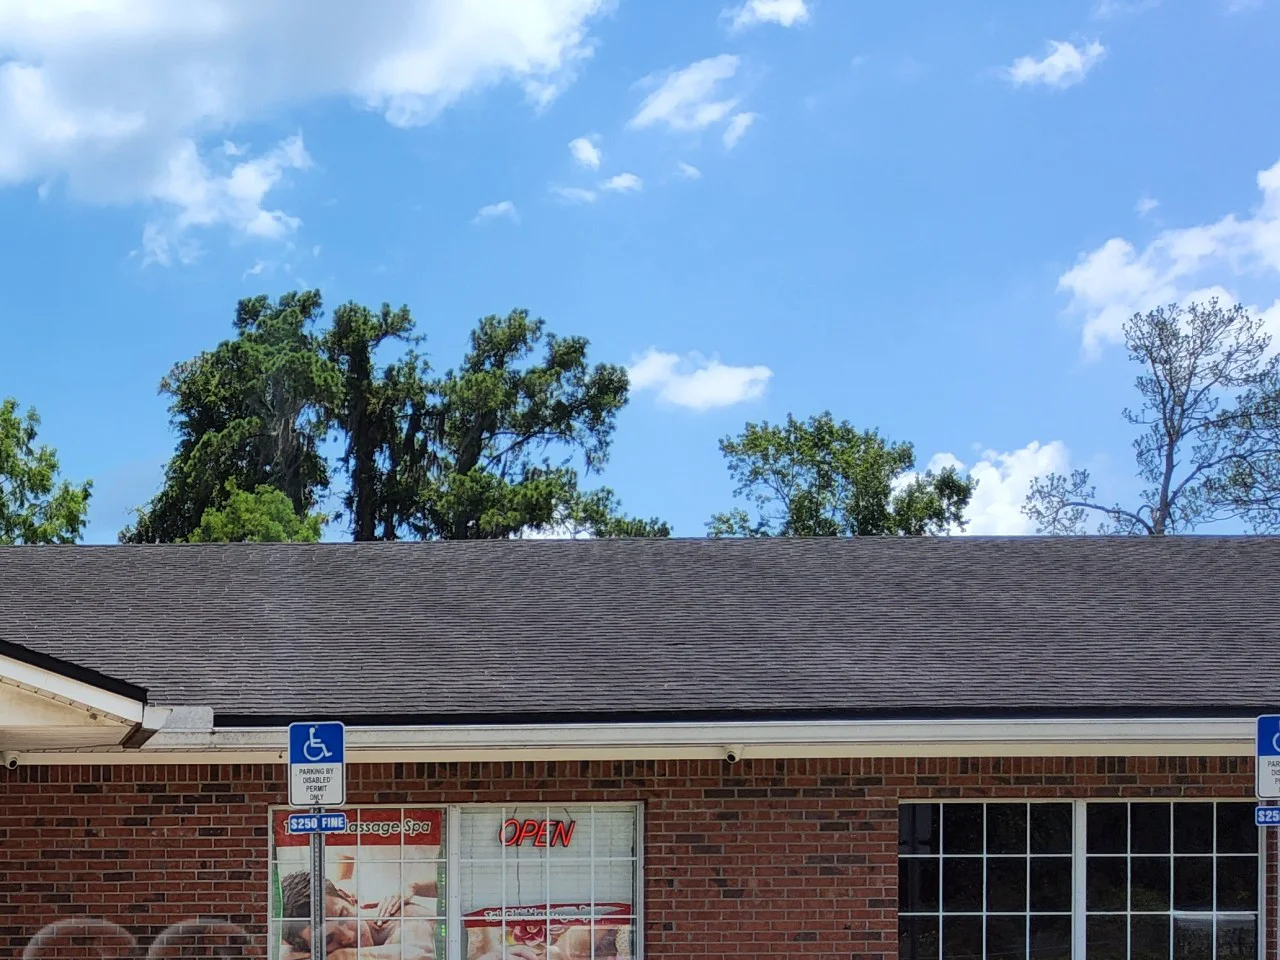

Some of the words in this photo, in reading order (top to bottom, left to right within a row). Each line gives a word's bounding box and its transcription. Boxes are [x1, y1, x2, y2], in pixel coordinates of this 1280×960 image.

[299, 767, 325, 775] PARKING
[326, 767, 335, 775] BY
[302, 776, 331, 784] DISABLED
[321, 816, 345, 829] FINE
[344, 820, 400, 837] assage
[403, 818, 432, 836] Spa
[499, 818, 576, 847] OPEN
